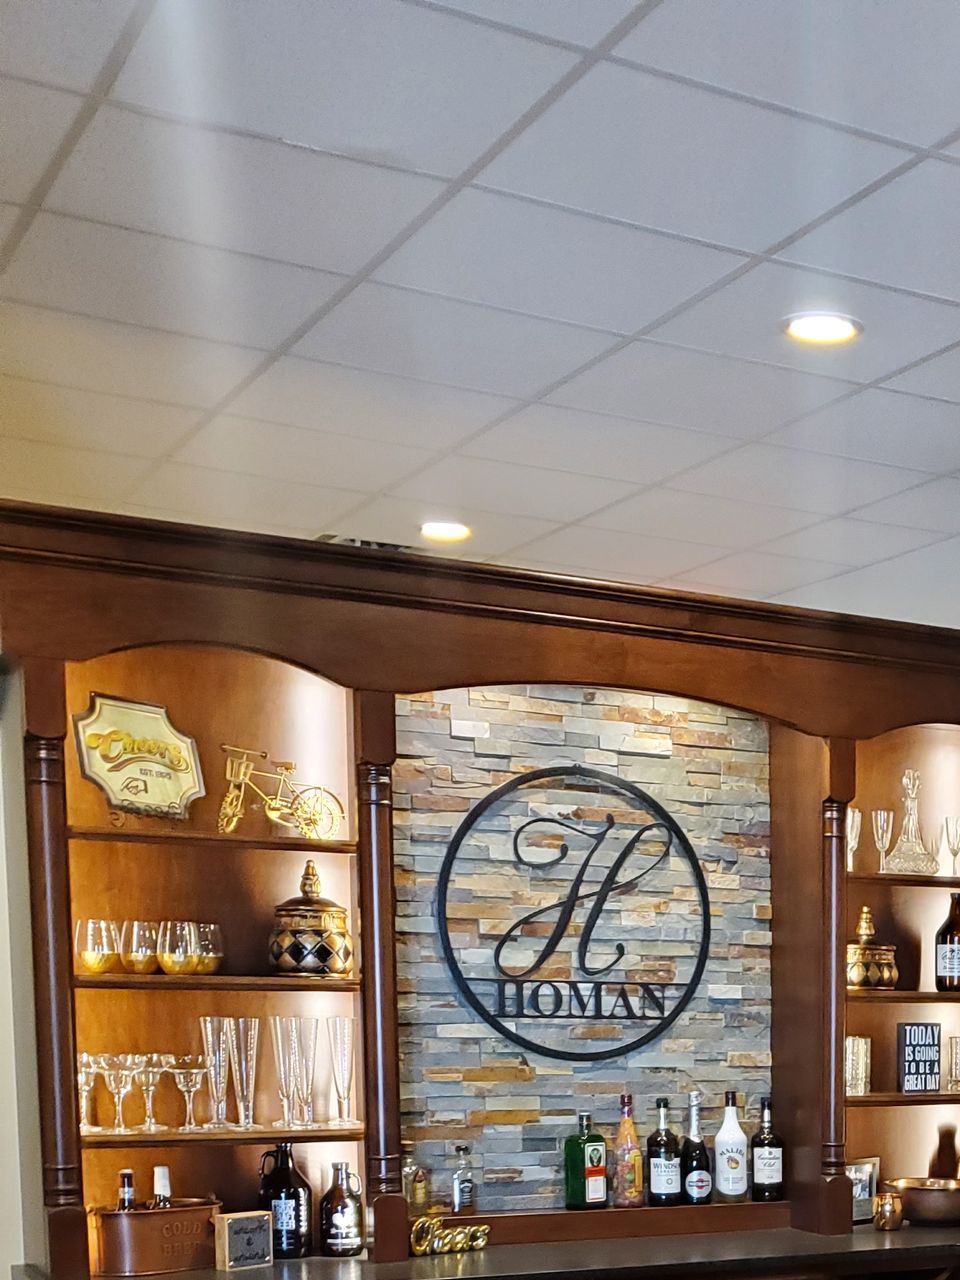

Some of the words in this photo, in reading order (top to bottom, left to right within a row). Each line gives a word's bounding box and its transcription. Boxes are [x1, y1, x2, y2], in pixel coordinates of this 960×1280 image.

[497, 982, 666, 1018] HOMAN
[904, 1026, 939, 1045] TODAY
[905, 1046, 914, 1061] IS
[915, 1046, 939, 1061] GOING
[904, 1062, 916, 1073] TO
[919, 1062, 930, 1073] BE
[933, 1062, 939, 1073] A
[904, 1074, 925, 1091] GREAT
[926, 1074, 940, 1090] DAY
[162, 1221, 202, 1237] COLD
[411, 1217, 490, 1255] Cheers
